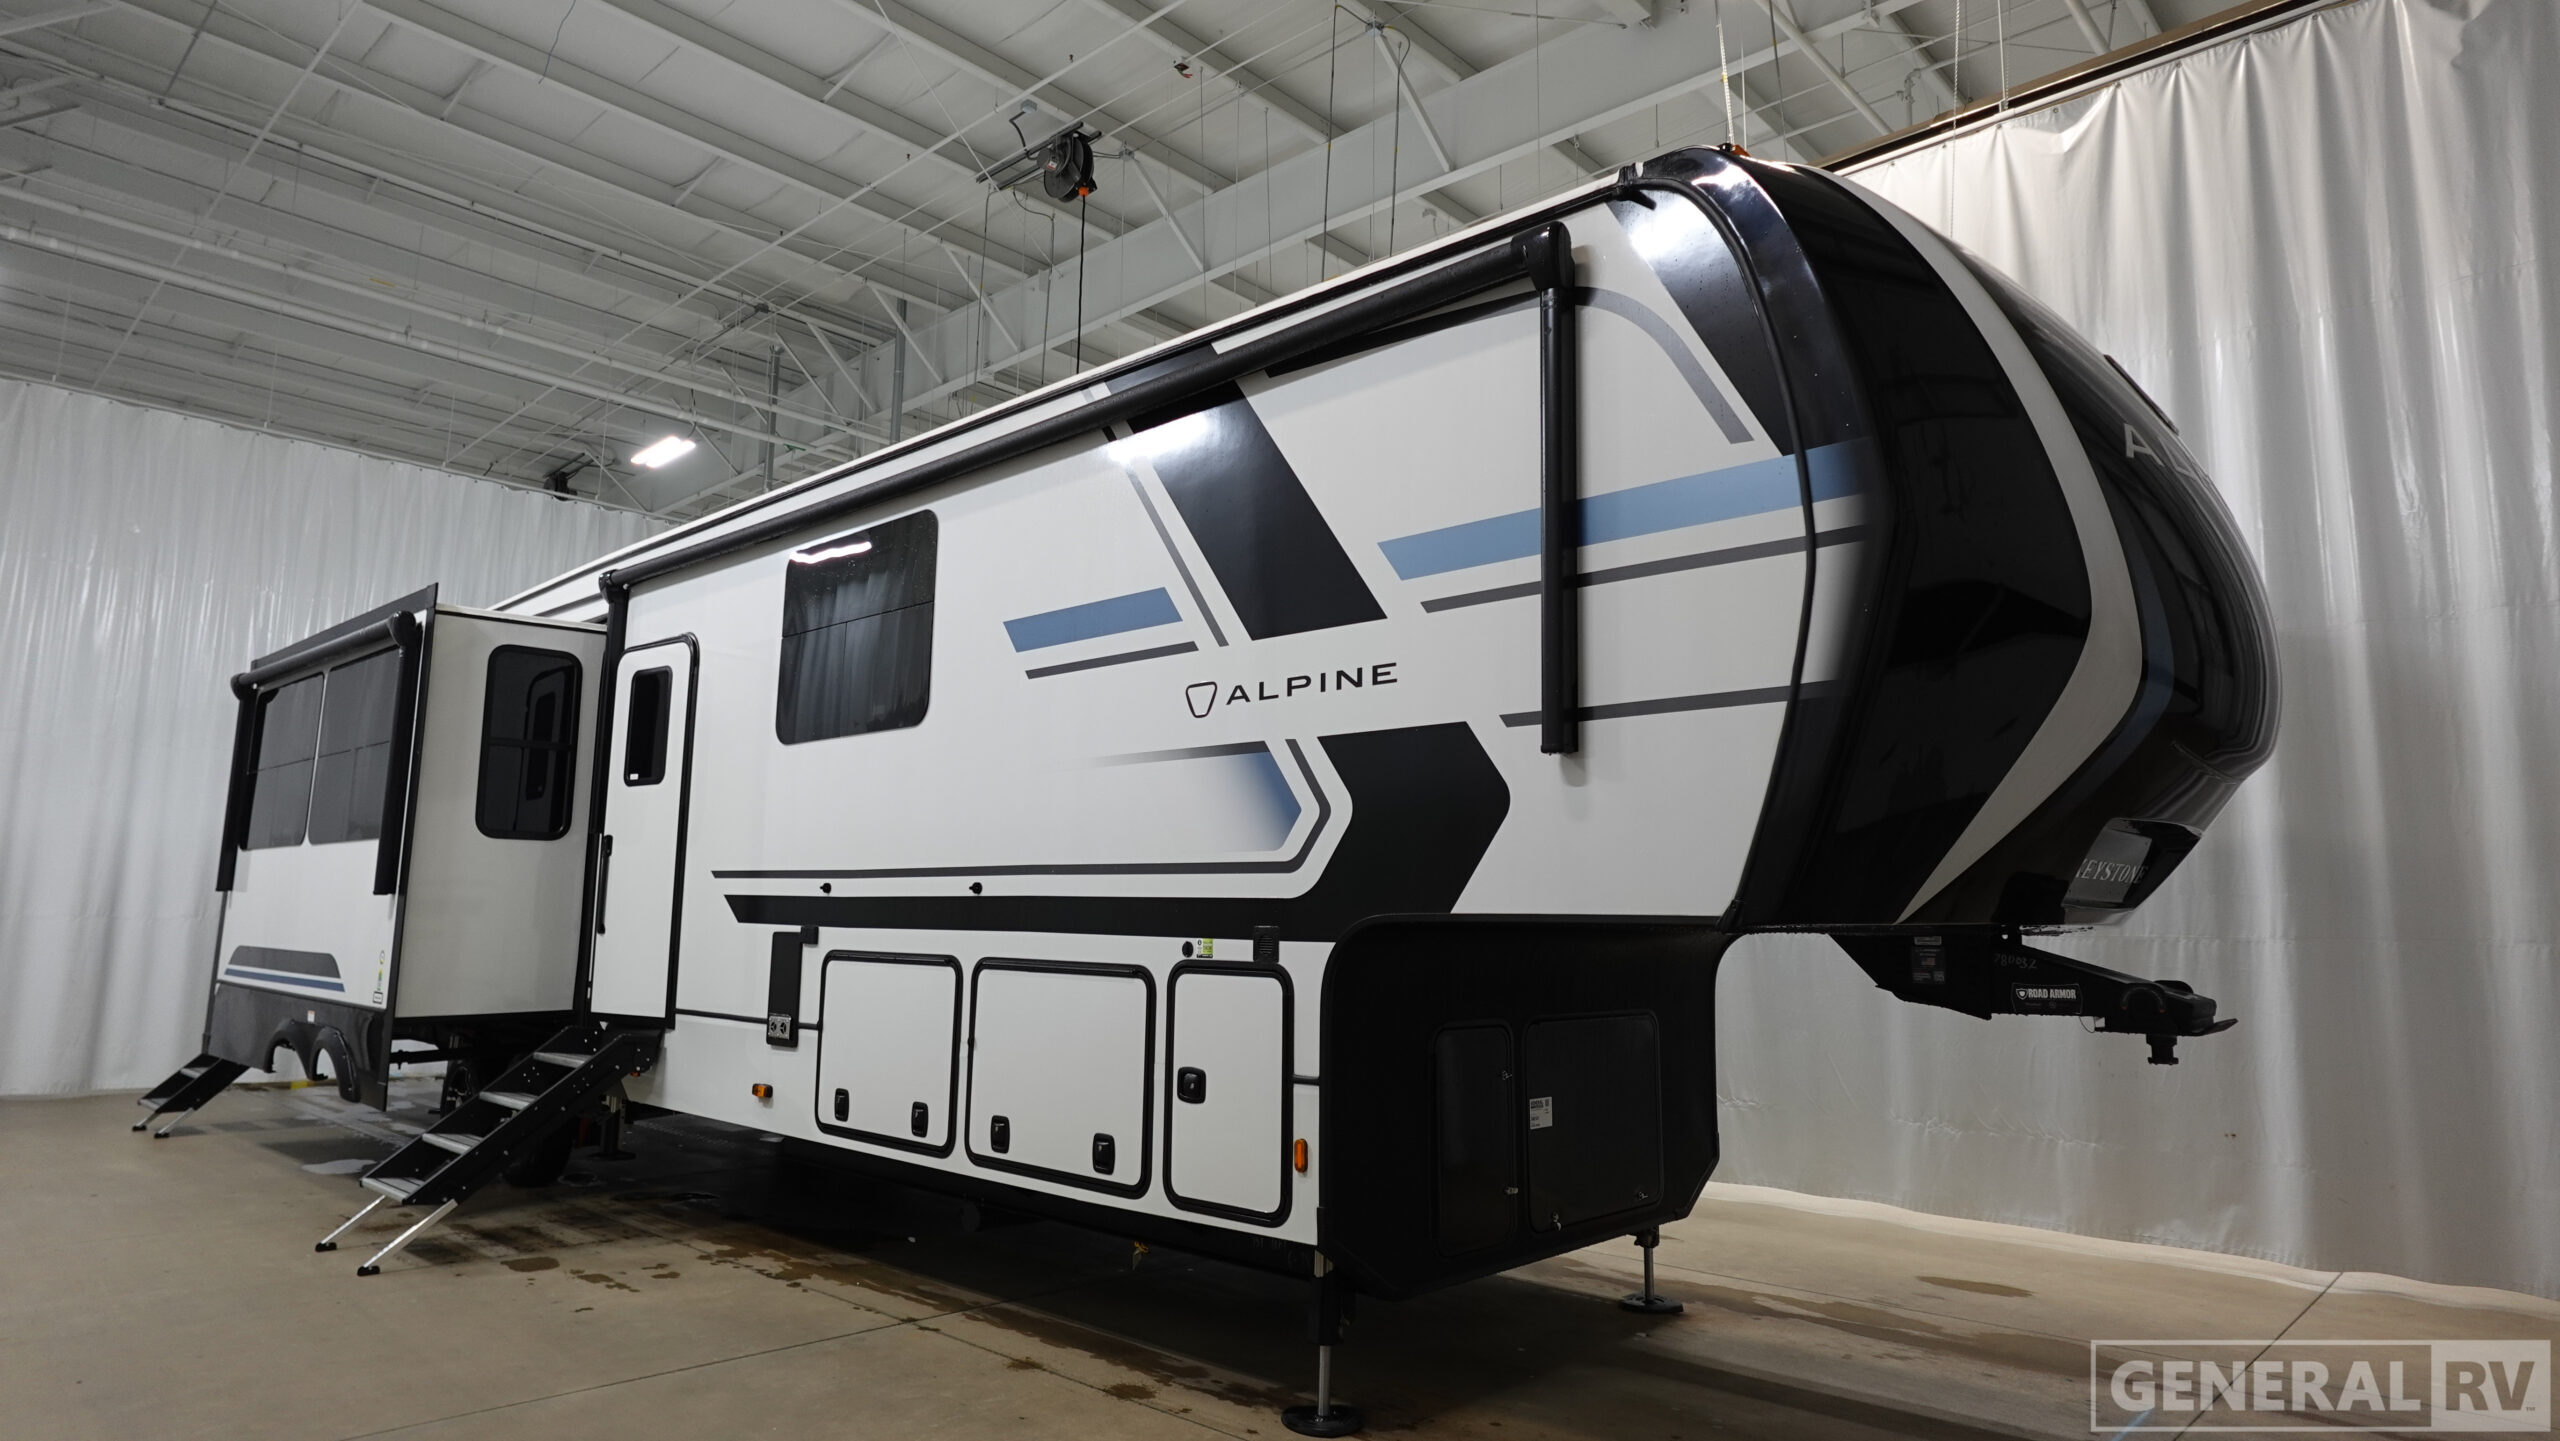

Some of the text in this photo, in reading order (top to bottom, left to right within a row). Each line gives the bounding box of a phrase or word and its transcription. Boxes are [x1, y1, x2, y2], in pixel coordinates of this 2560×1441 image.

[1226, 662, 1398, 705] ALPINE
[2028, 988, 2077, 1000] ROAD ARMOR
